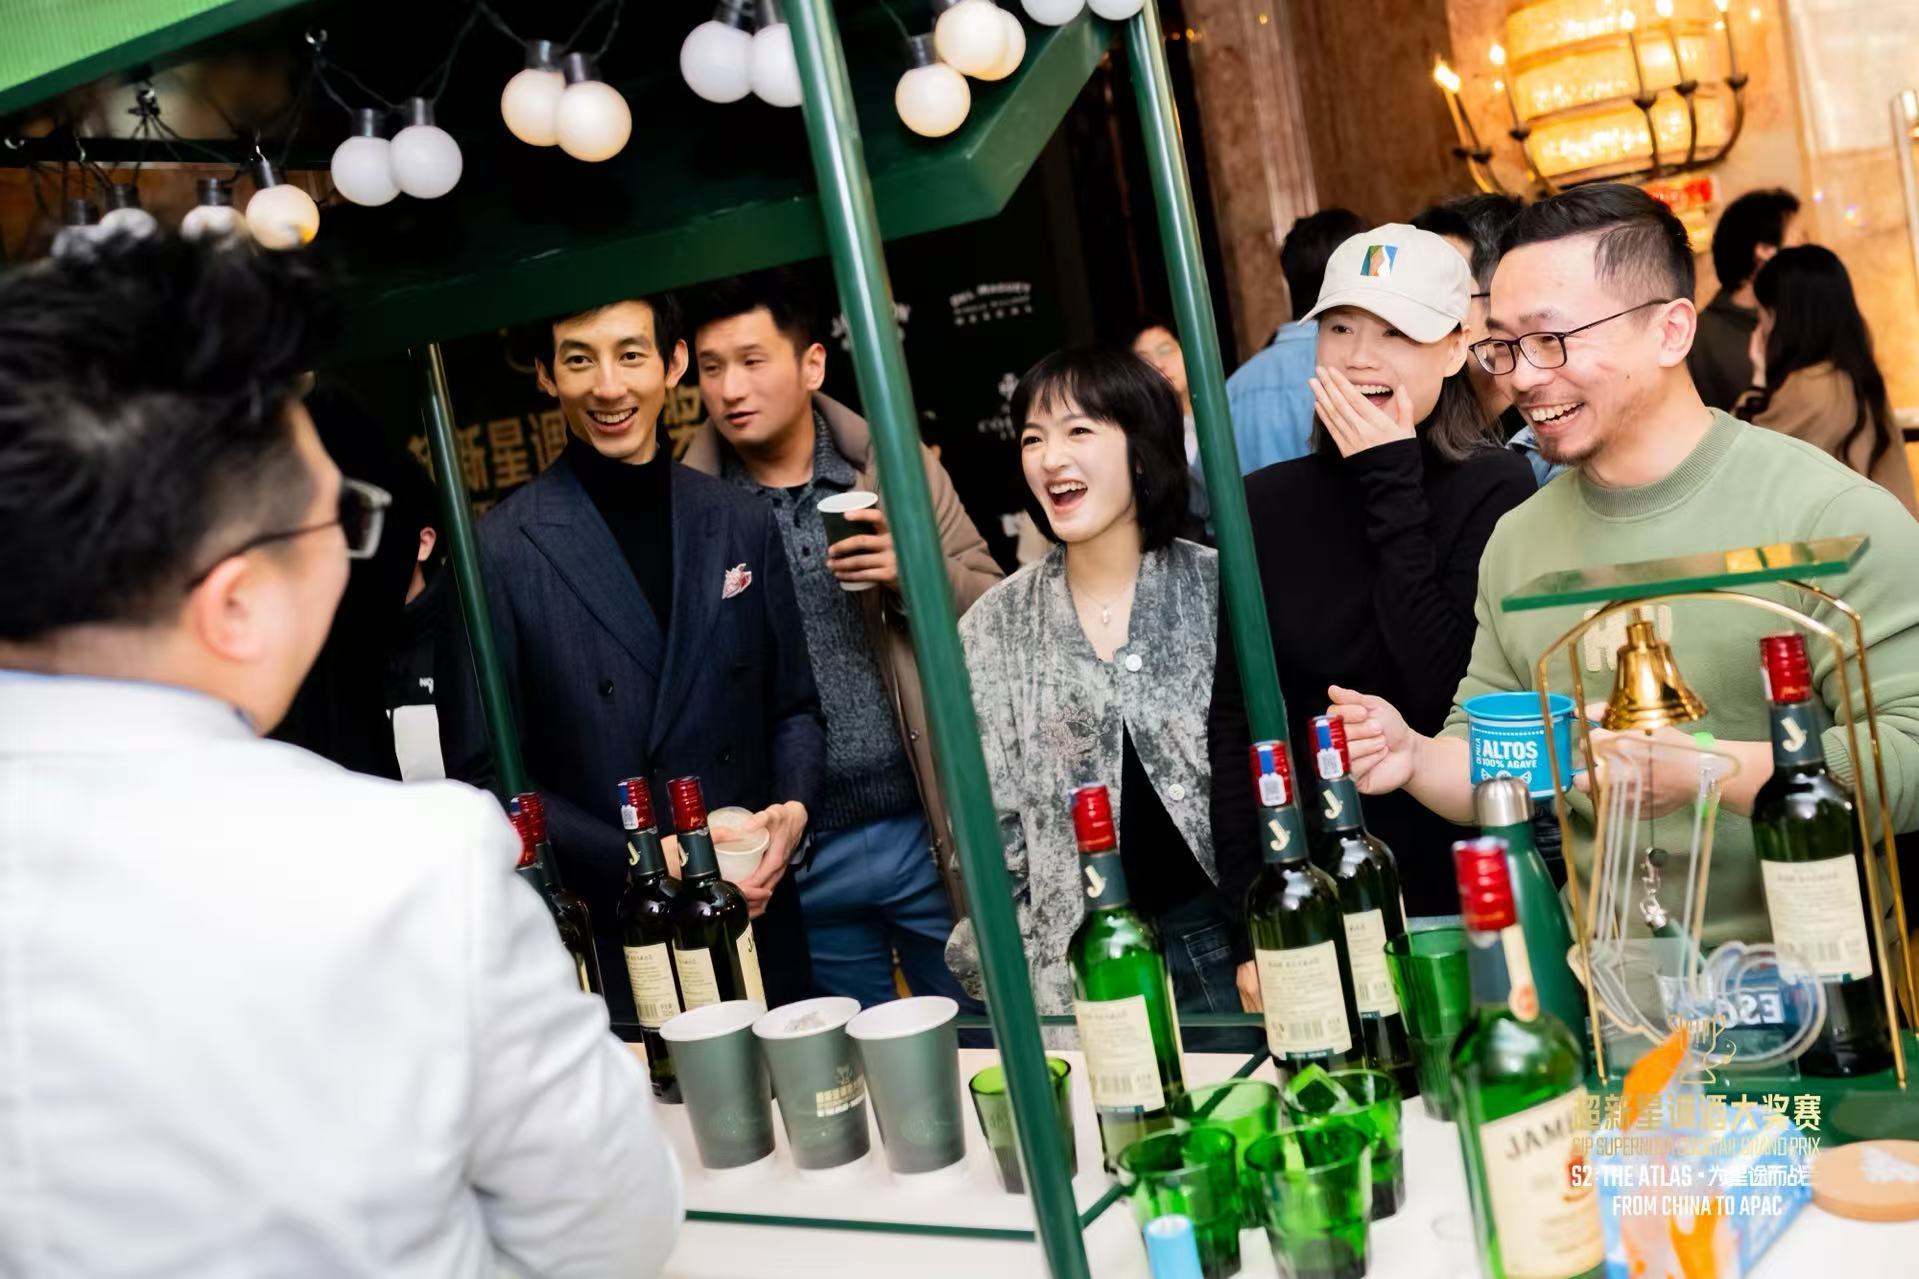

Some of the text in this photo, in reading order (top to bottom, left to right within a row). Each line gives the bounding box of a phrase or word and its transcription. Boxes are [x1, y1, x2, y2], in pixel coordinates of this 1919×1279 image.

[1482, 740, 1539, 760] ALTOS
[1482, 758, 1537, 769] 100% AGAVE
